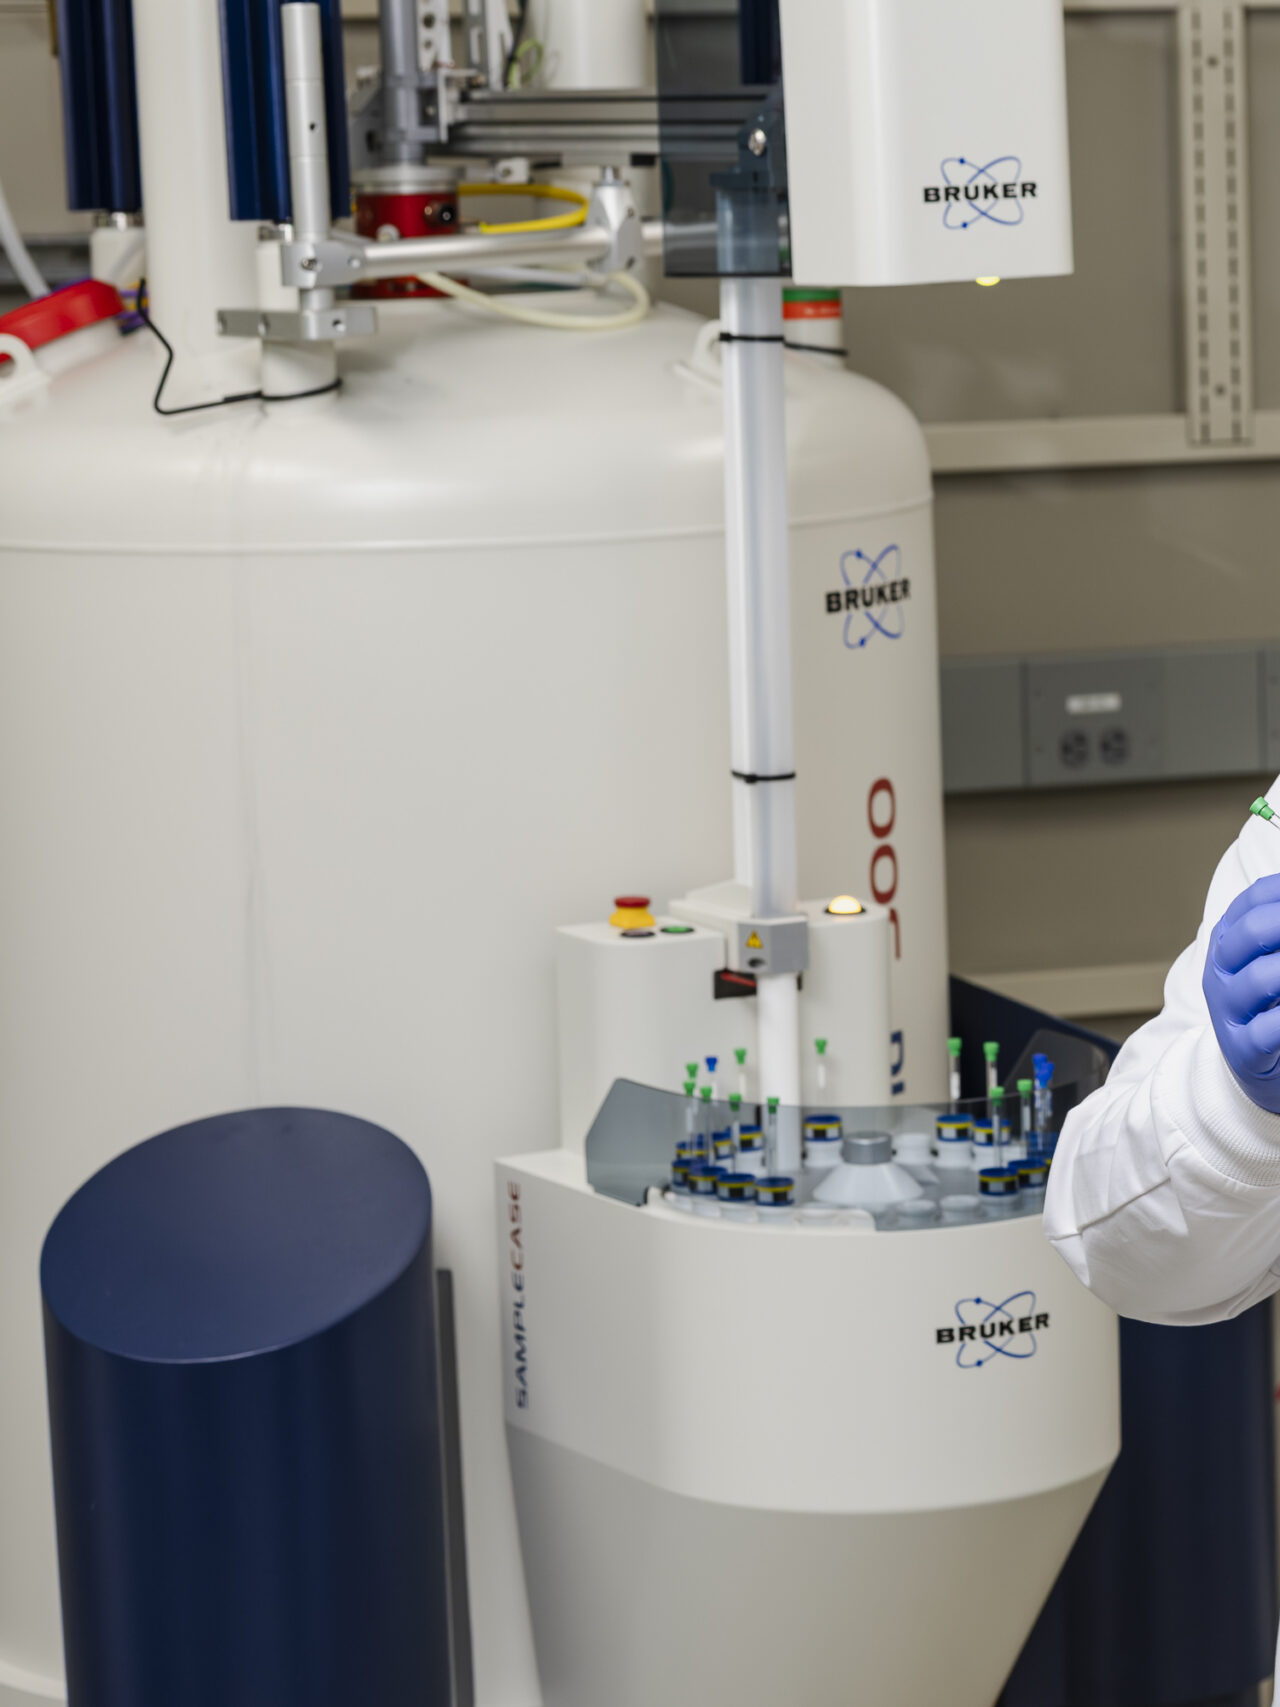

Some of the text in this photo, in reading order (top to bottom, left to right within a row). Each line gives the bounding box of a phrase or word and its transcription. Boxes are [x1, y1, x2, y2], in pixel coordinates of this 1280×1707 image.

[923, 181, 1037, 203] BRUKER
[825, 578, 911, 614] BRUKER
[508, 1180, 528, 1410] SAMPLECASE
[936, 1312, 1050, 1344] BRUKER
